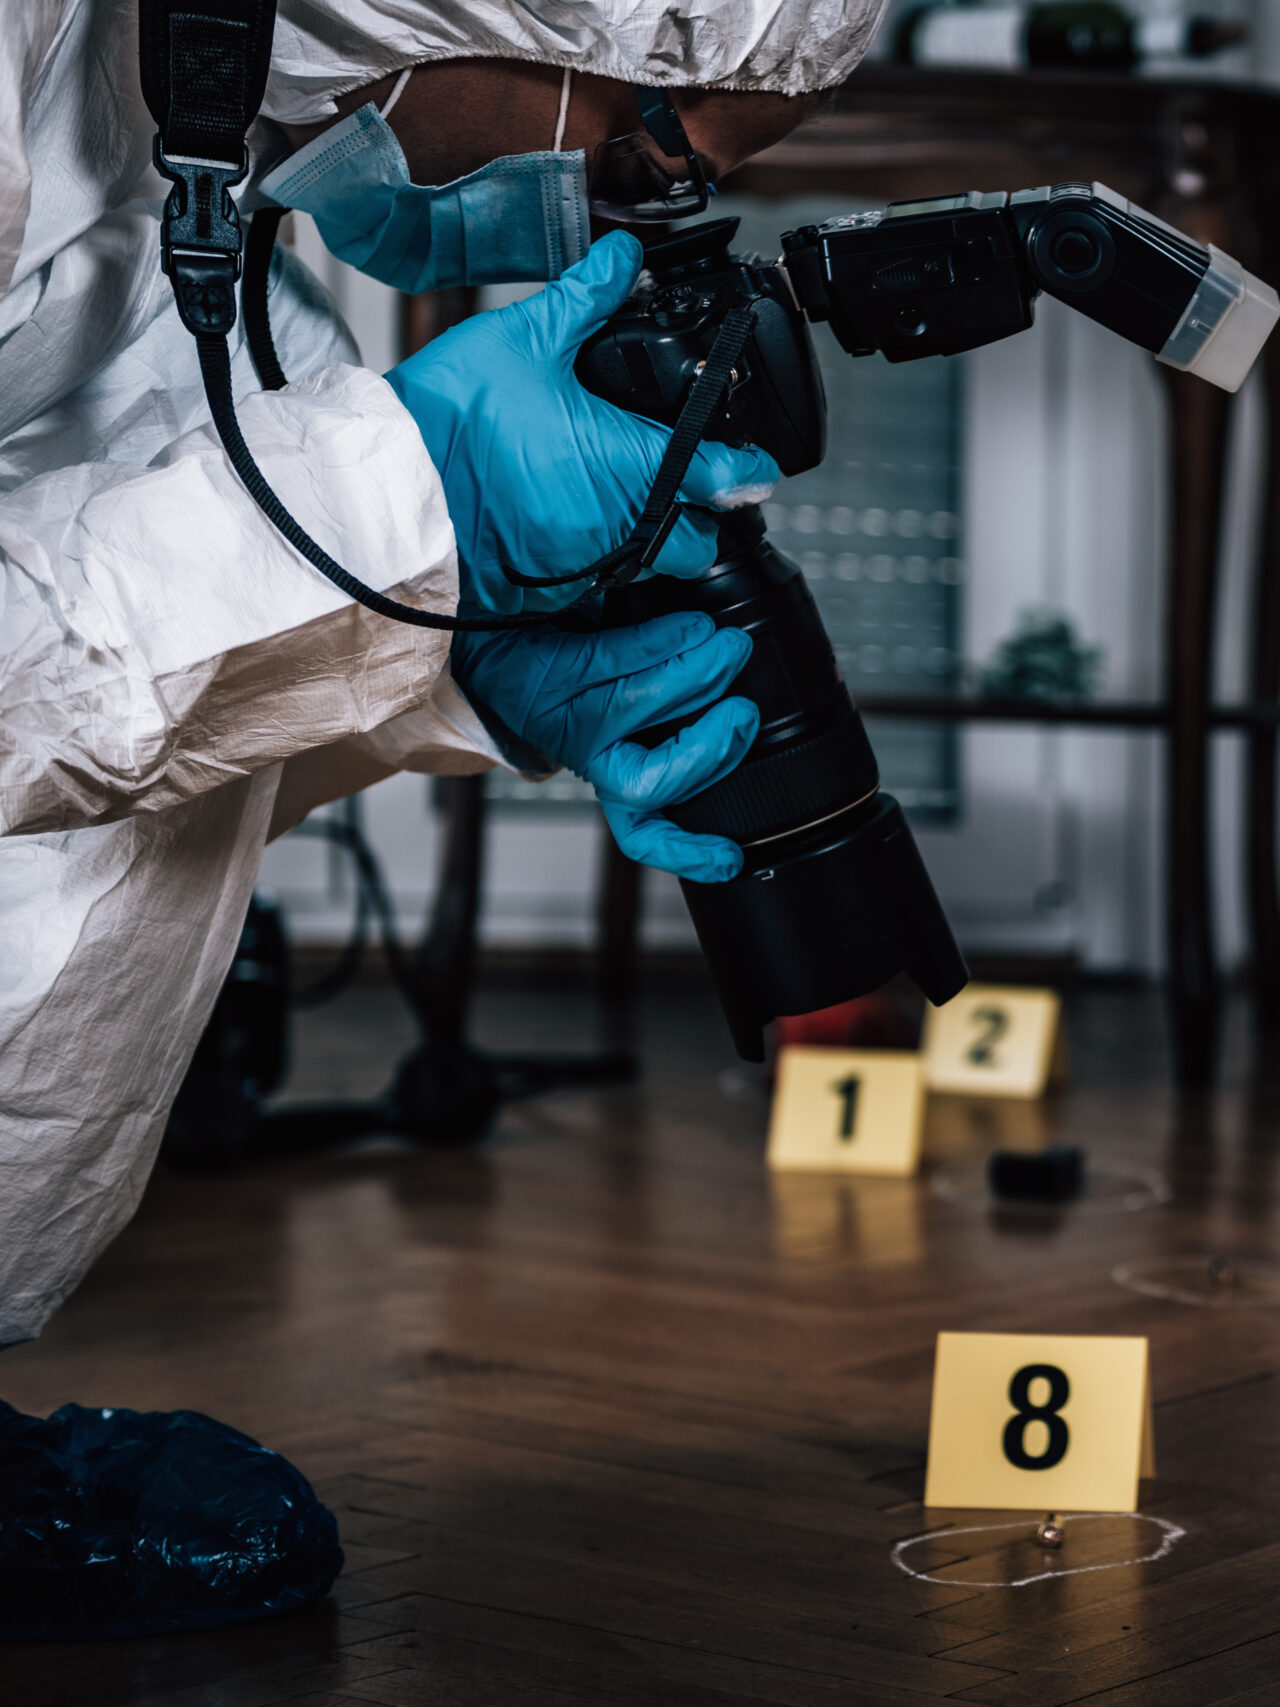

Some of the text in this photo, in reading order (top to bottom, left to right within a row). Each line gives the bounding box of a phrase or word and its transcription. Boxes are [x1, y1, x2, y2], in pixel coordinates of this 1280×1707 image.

[965, 1002, 1011, 1068] 2
[832, 1071, 863, 1143] 1
[1001, 1363, 1071, 1472] 8
